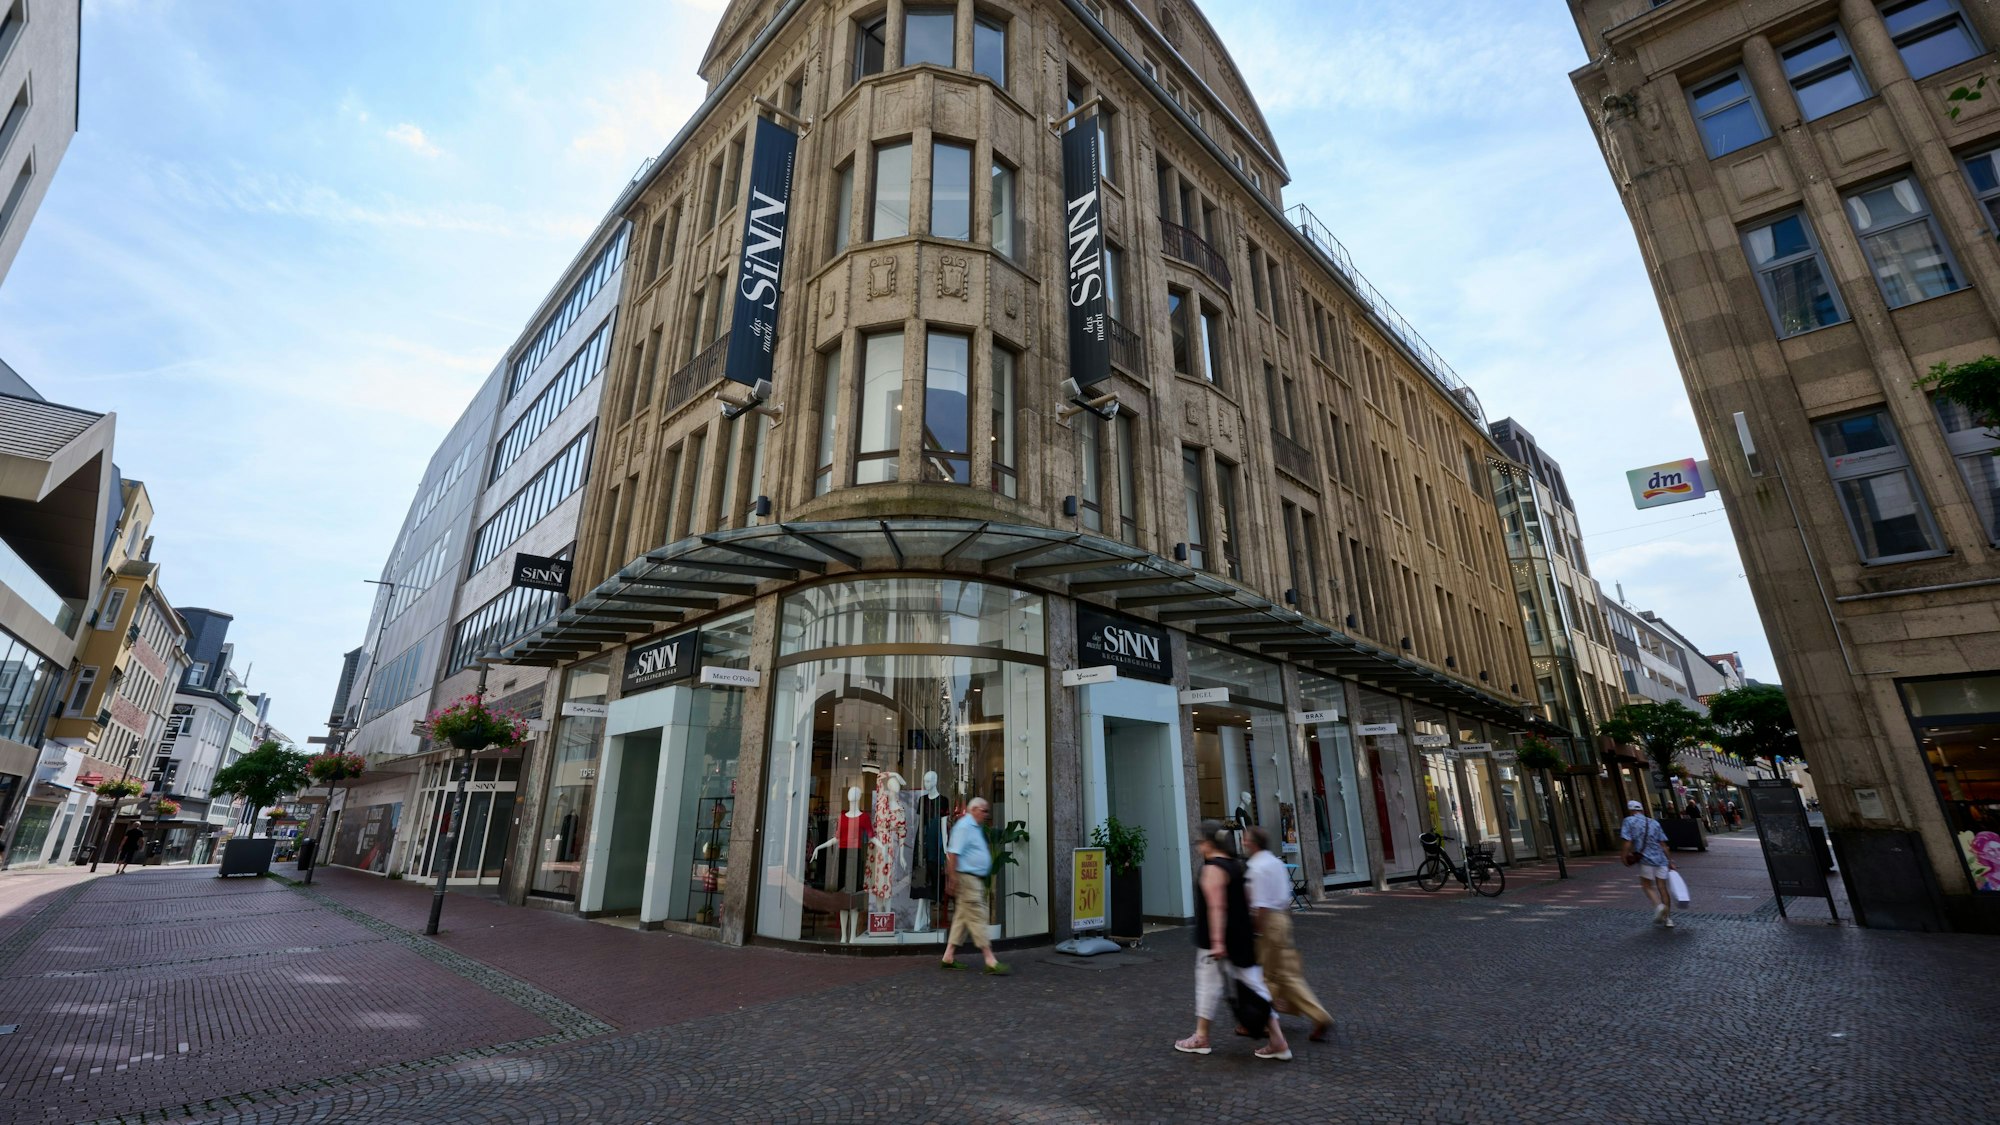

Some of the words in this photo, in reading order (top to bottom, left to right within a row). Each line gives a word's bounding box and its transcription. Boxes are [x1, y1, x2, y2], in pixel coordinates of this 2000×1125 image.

[740, 185, 787, 310] SiNN
[1067, 186, 1103, 307] SiNN
[749, 317, 764, 337] das
[1083, 316, 1093, 334] das
[762, 322, 773, 353] macht
[1648, 471, 1682, 489] dm
[520, 566, 563, 583] SiNN
[1103, 625, 1162, 663] SiNN
[636, 642, 679, 676] SiNN
[712, 672, 731, 680] Marc
[731, 674, 755, 683] O'Polo
[1191, 691, 1212, 699] DIGEL
[1305, 712, 1324, 720] BRAX
[1081, 868, 1098, 880] SALE
